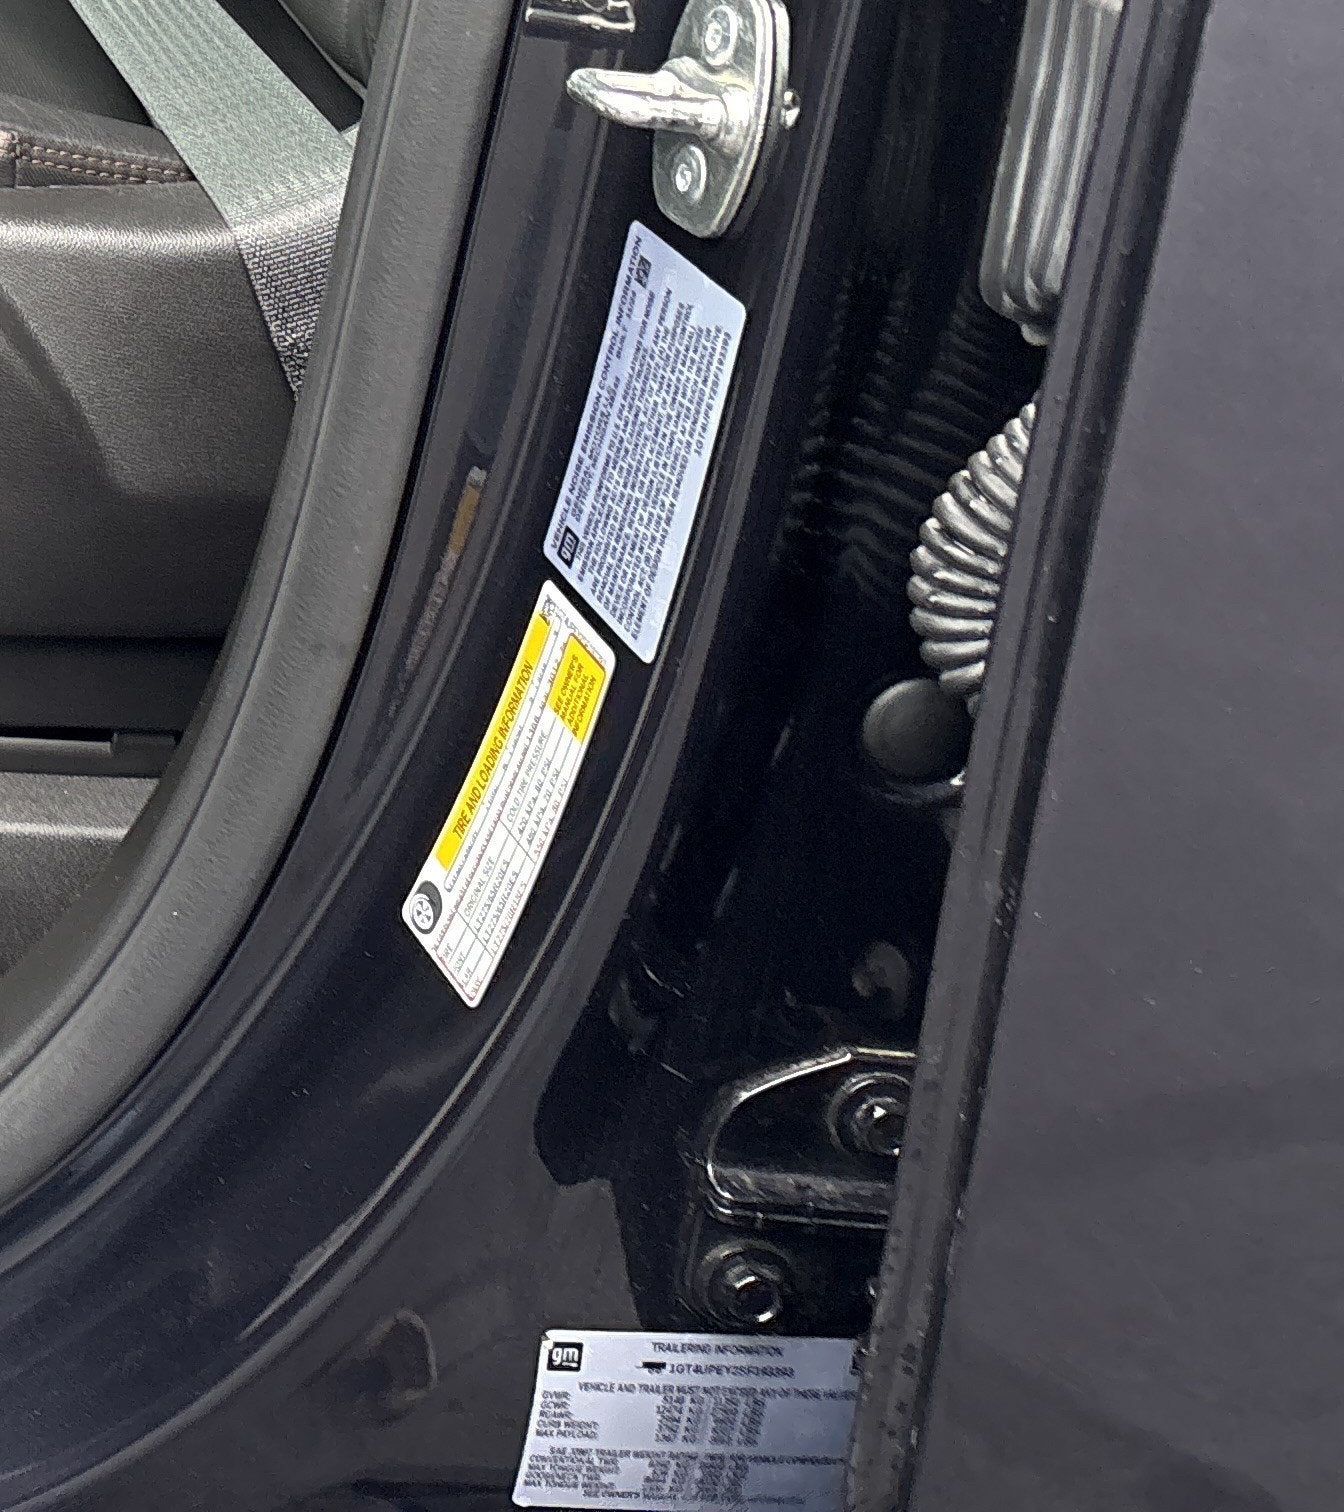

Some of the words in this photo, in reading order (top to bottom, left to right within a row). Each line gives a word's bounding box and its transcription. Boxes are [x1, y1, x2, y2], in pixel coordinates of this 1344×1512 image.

[551, 493, 571, 552] VEHICLE
[568, 453, 584, 496] NOISE
[580, 390, 602, 454] EMISSION
[597, 327, 619, 391] CONTROL
[613, 234, 643, 326] INFORMATION
[452, 807, 471, 842] TIRE
[464, 783, 482, 816] AND
[474, 734, 503, 791] LOADING
[495, 658, 535, 740] INFORMATION
[549, 1346, 581, 1367] gm
